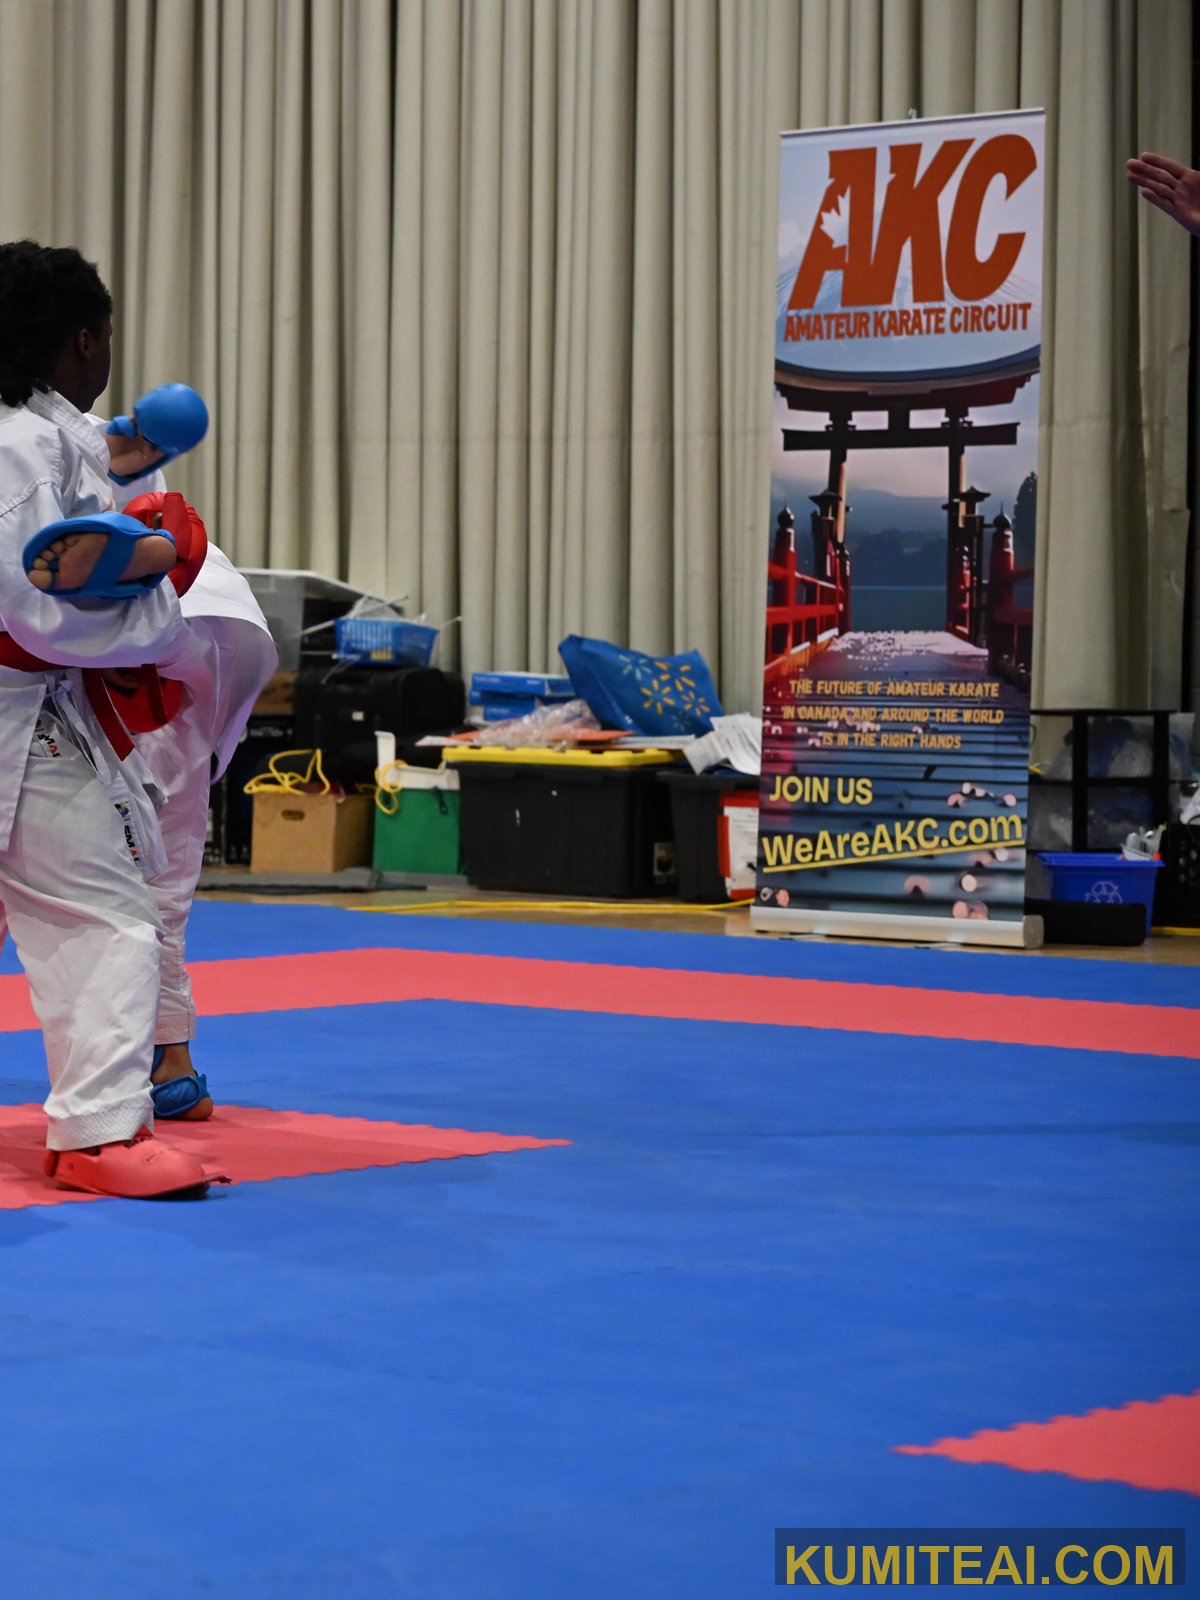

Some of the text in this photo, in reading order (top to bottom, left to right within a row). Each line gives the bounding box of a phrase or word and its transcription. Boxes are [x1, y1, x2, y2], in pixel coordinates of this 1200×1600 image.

[787, 134, 1038, 310] AKC
[784, 302, 1032, 342] AMATEUR KARATE CIRCUIT
[789, 679, 1000, 697] THE FUTURE OF AMATEUR KARATE
[783, 706, 1004, 724] IN CANADA AND AROUND THE WORLD
[822, 732, 961, 749] IS IN THE RIGHT HANDS
[769, 776, 873, 805] JOIN US
[762, 814, 1024, 867] WeAreAKC.com
